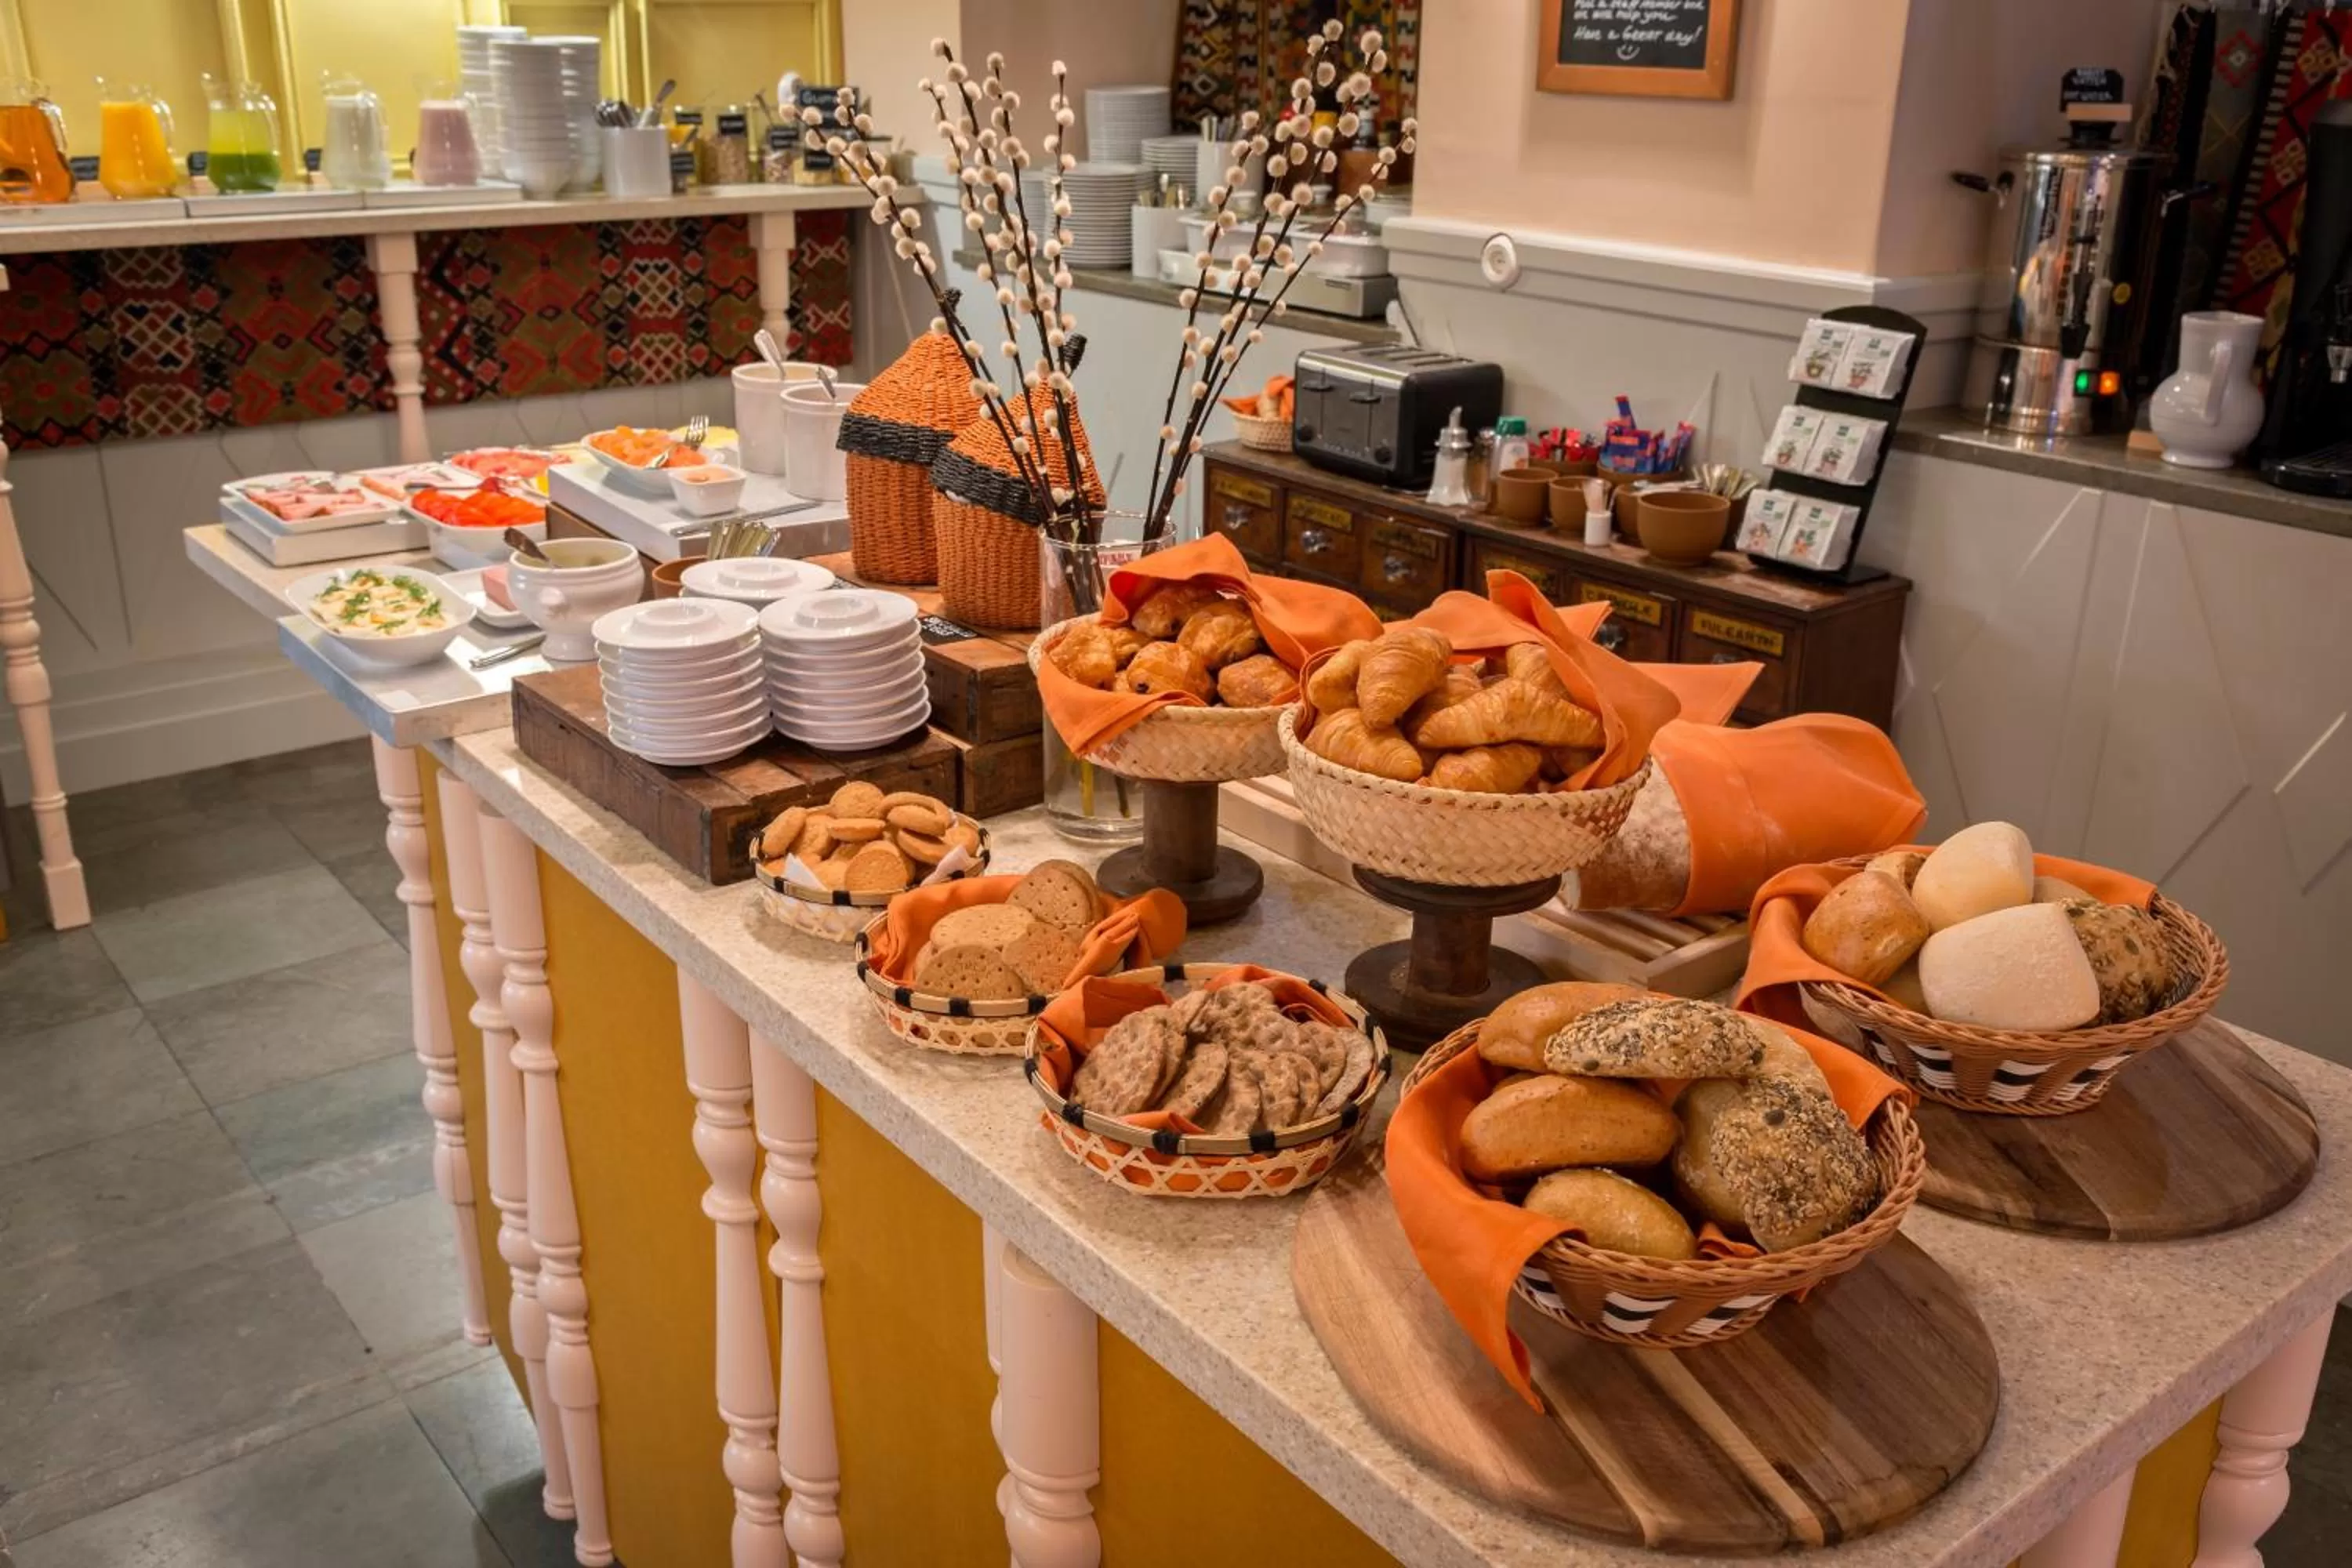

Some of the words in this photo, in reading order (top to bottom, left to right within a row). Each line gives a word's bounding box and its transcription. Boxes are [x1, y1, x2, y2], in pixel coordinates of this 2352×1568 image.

[1574, 25, 1602, 40] Have
[1607, 29, 1620, 40] a
[1664, 25, 1704, 46] day!
